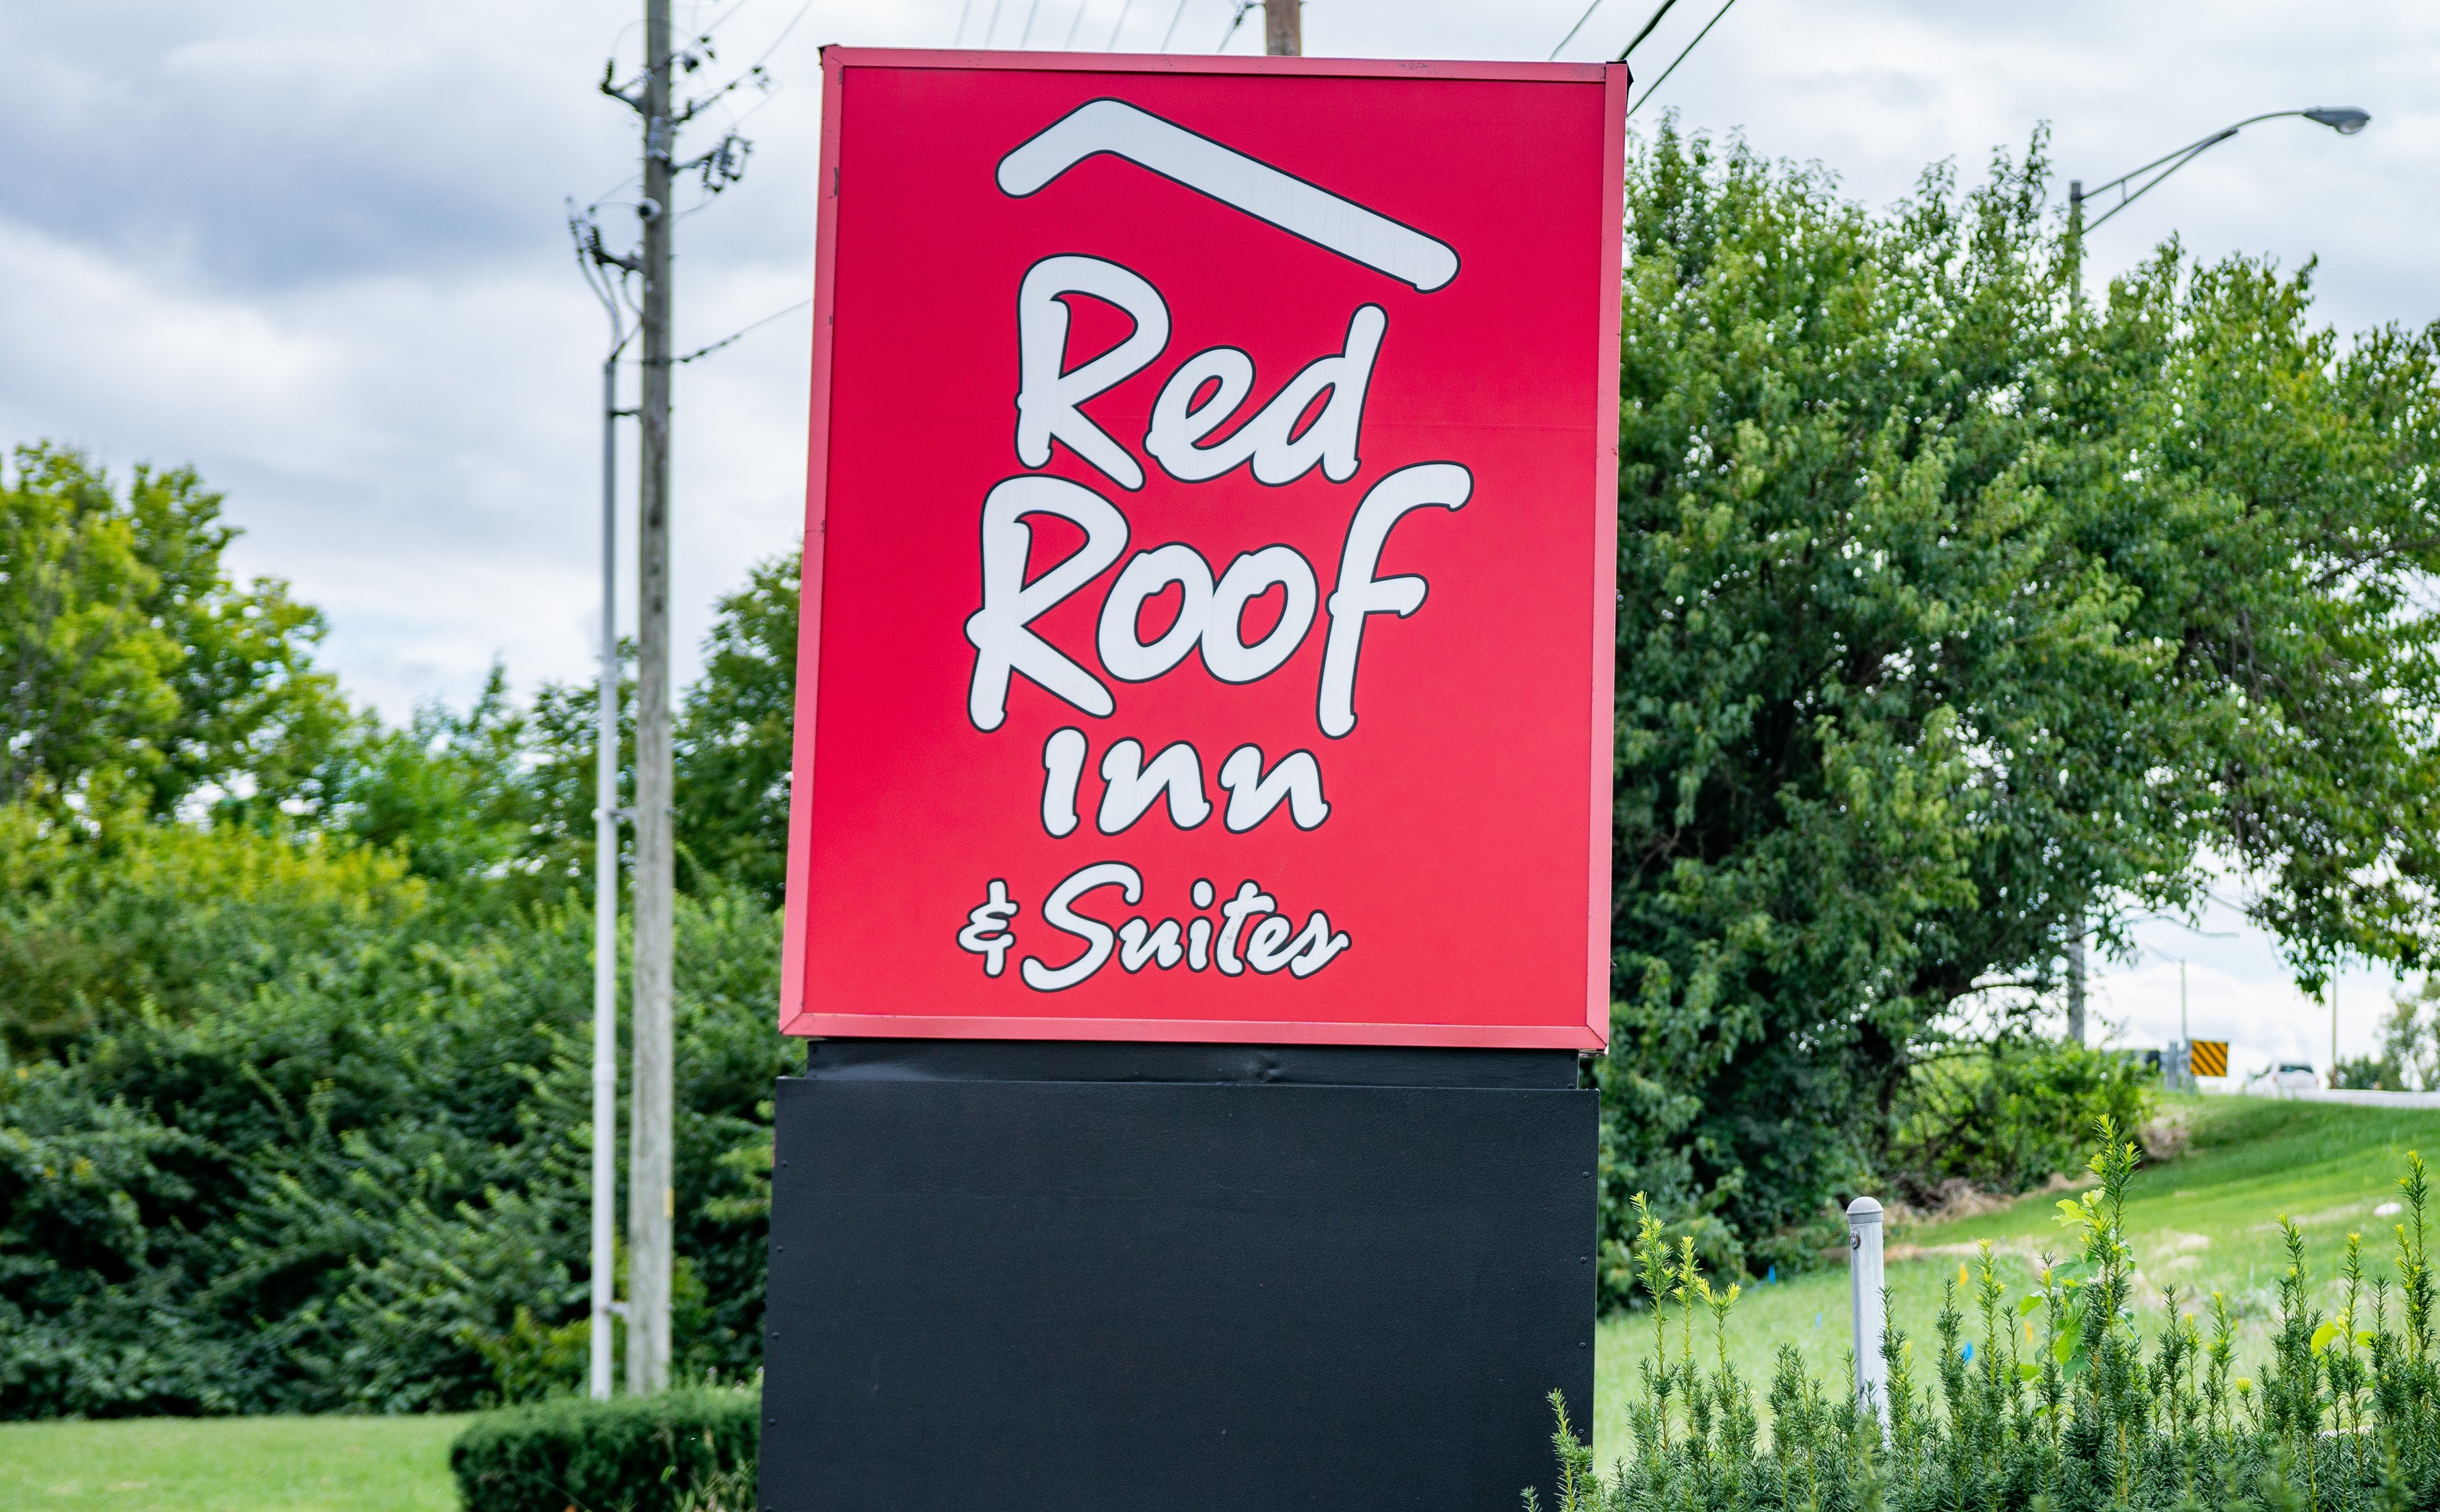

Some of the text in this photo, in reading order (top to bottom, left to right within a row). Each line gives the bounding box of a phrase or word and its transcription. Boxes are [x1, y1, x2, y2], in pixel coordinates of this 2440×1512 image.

[1016, 254, 1387, 489] Red
[965, 461, 1473, 737] Roof
[957, 862, 1351, 992] & Suites
